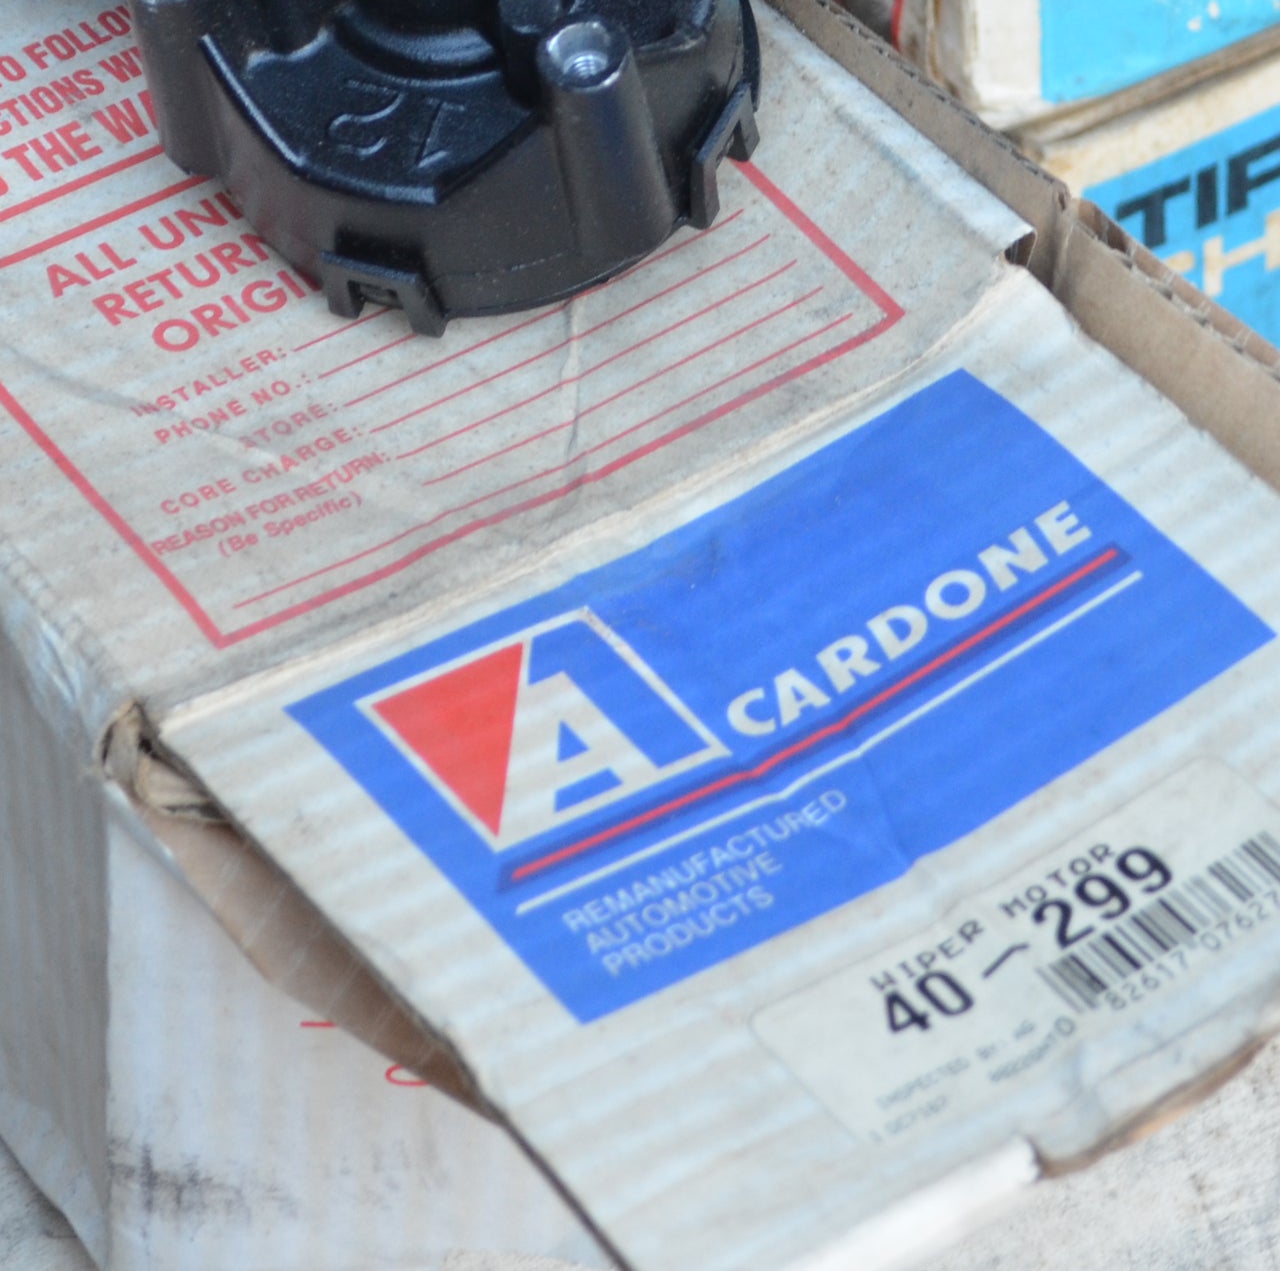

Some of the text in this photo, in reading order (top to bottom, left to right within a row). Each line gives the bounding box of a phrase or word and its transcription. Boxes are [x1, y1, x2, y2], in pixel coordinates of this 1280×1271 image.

[22, 5, 134, 70] FOLLO
[1, 121, 104, 182] THE
[46, 242, 138, 298] ALL
[152, 266, 324, 353] ORIGI
[130, 347, 287, 418] INSTALLER:
[153, 399, 248, 445] PHONE
[238, 402, 339, 450] STORE:
[148, 451, 392, 557] REASON FOR RETURN:
[160, 426, 365, 515] CORE CHARGE:
[217, 490, 363, 558] (Be Specific)
[726, 500, 1093, 737] CARDONE
[562, 786, 850, 935] REMANUFACTURED
[585, 849, 784, 957] AUTOMOTIVE
[600, 883, 776, 979] PRODUCTS
[869, 841, 1117, 994] WIPER MOTOR
[1102, 947, 1192, 1013] 82617
